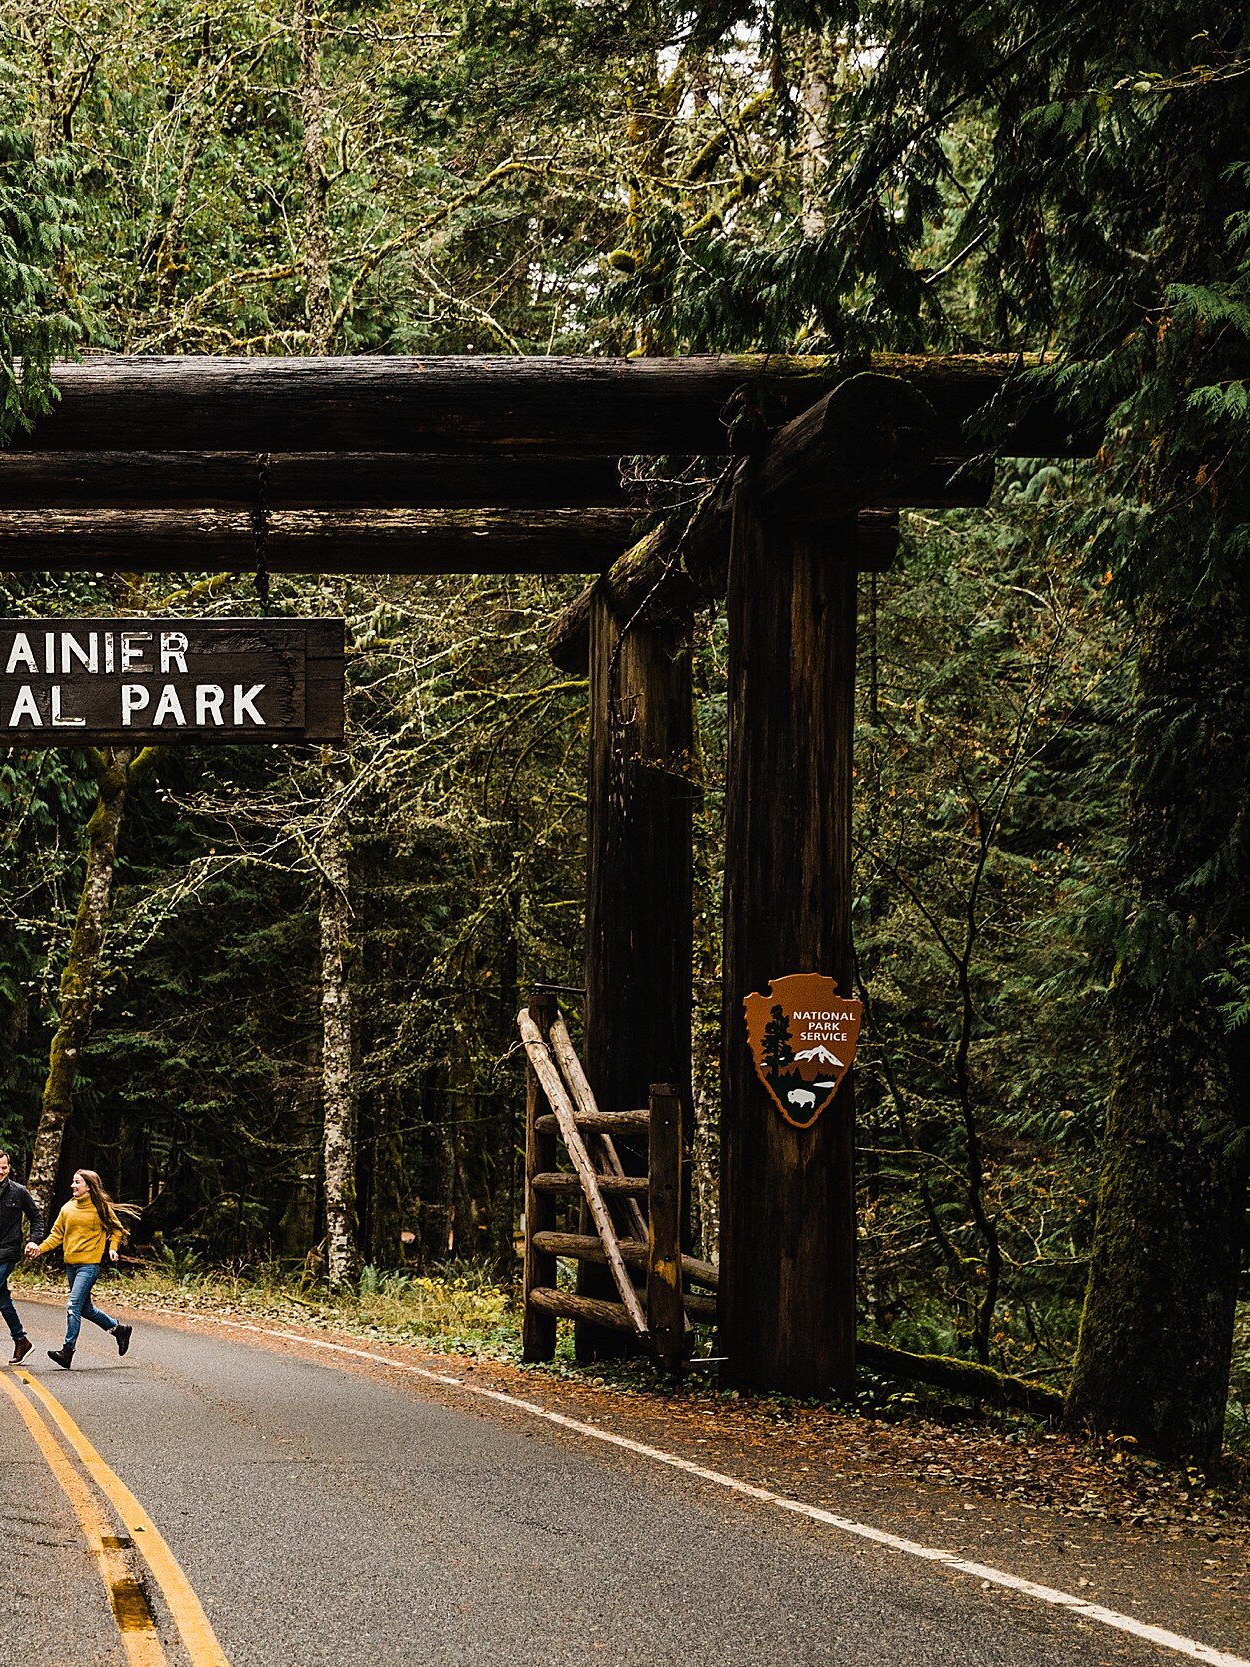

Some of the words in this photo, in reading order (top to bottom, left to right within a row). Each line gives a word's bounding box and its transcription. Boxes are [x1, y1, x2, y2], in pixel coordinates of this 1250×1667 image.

[121, 683, 267, 727] PARK
[792, 1011, 856, 1021] NATIONAL
[807, 1022, 840, 1031] PARK
[799, 1032, 848, 1042] SERVICE
